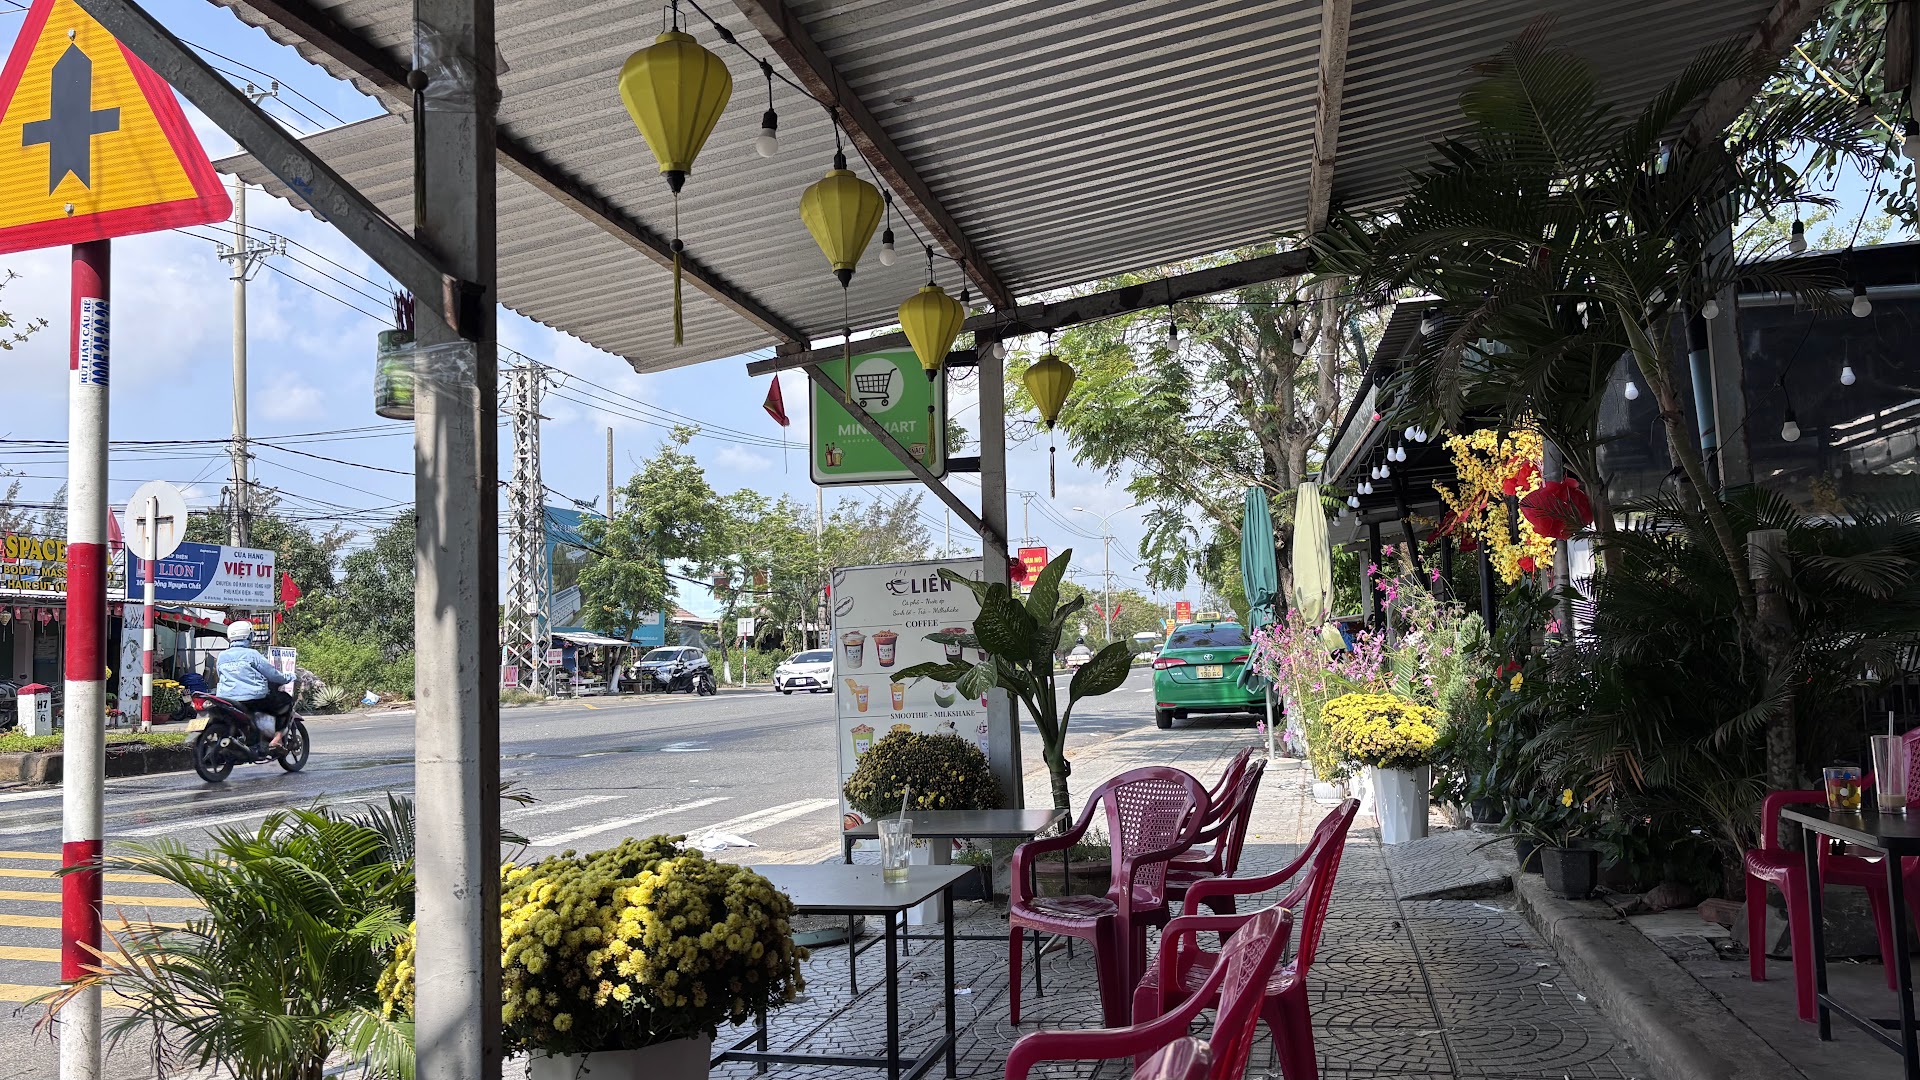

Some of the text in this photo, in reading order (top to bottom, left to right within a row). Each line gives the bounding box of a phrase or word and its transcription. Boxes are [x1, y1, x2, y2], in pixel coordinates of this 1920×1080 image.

[838, 424, 870, 436] MIN
[5, 535, 68, 563] SPACE
[3, 565, 33, 575] BODY
[159, 563, 195, 577] LION
[224, 560, 272, 578] VIỆT ÚT
[8, 580, 52, 591] HAIRCUT
[912, 574, 951, 593] LIÊN
[905, 620, 938, 628] COFFEE
[37, 700, 47, 709] H7
[40, 714, 46, 722] 6
[934, 710, 975, 718] MILKSHAKE
